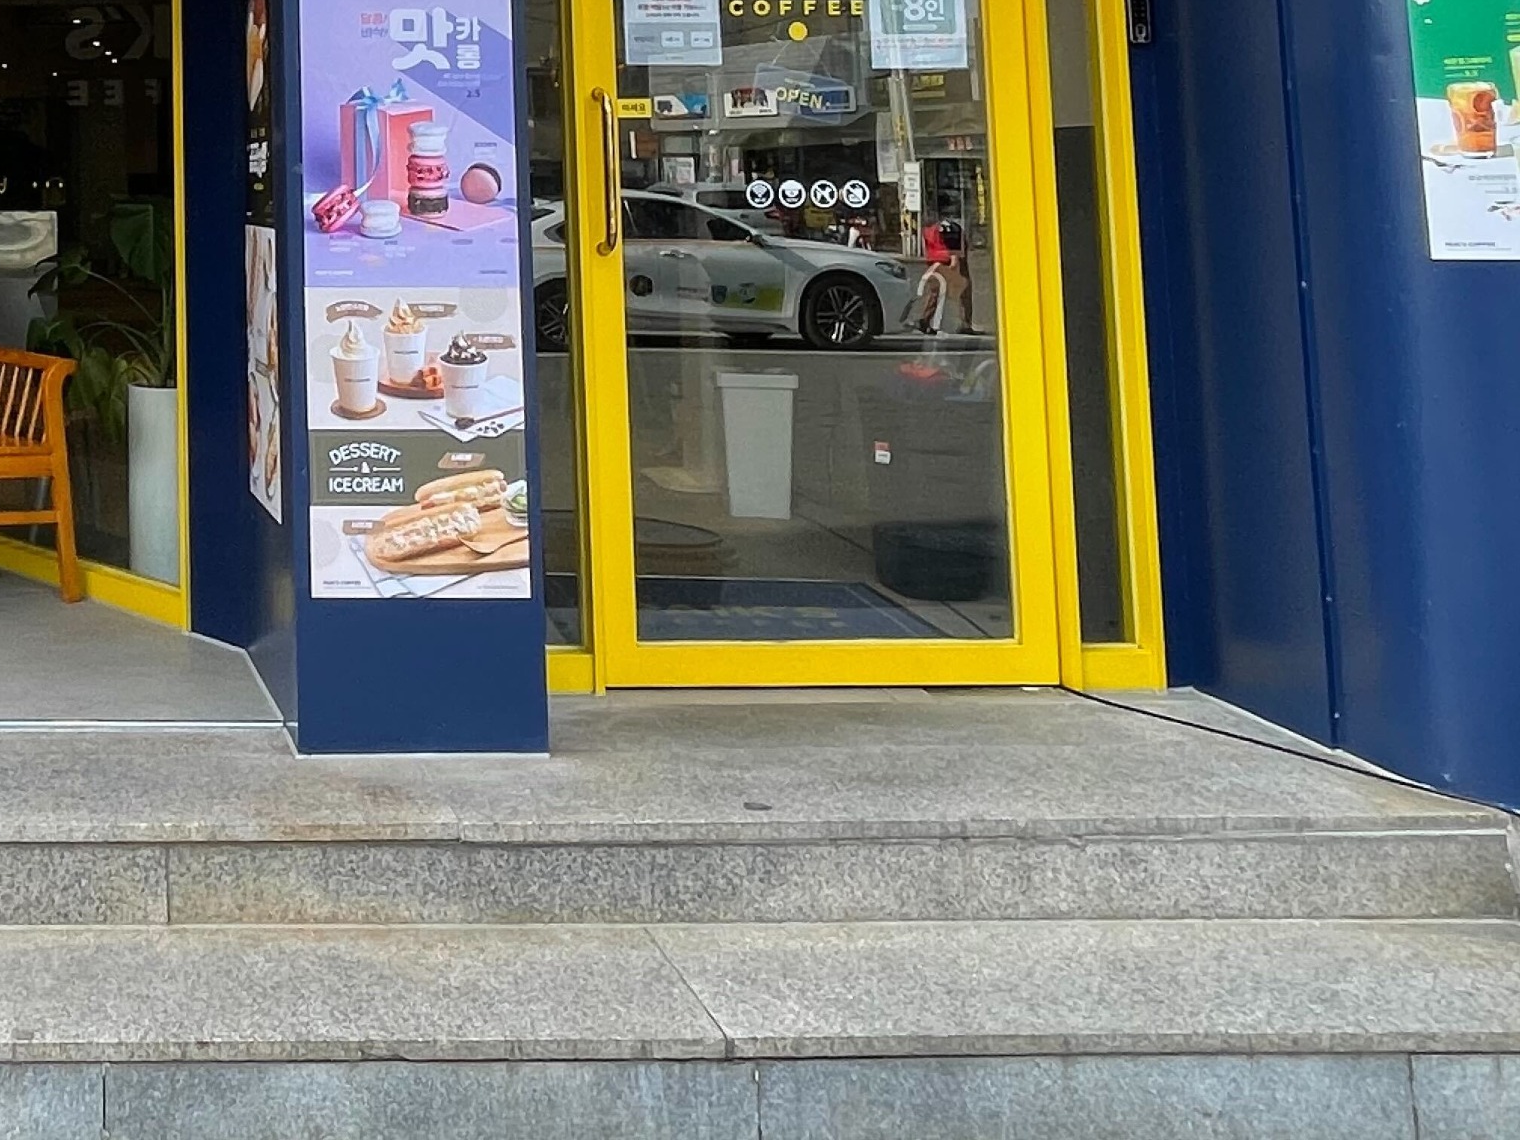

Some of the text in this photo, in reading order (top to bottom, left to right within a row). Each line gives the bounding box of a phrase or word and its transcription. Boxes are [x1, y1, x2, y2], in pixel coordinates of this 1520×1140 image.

[729, 0, 864, 16] COFFEE
[329, 442, 401, 465] DESSERT
[329, 477, 404, 492] ICECREAM
